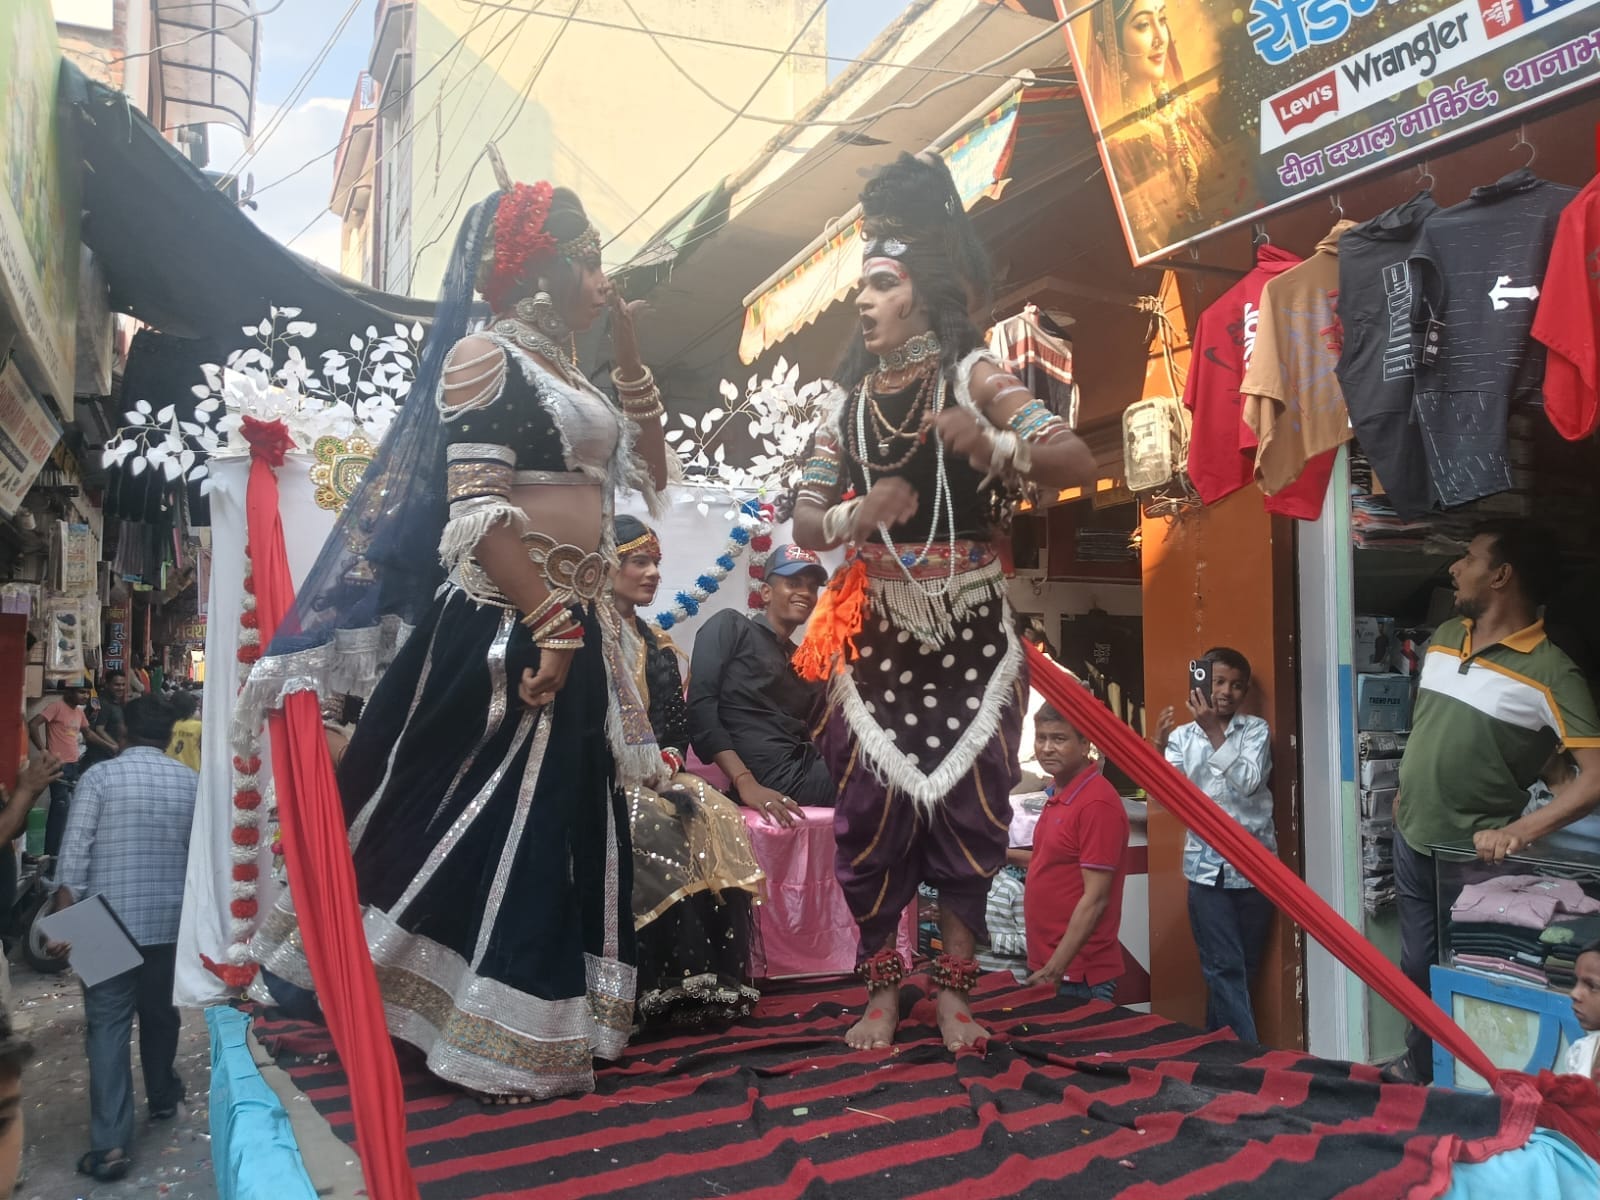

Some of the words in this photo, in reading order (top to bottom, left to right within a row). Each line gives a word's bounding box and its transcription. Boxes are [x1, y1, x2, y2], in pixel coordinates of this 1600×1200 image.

[1341, 11, 1469, 94] Wrangler
[1277, 153, 1325, 187] दीन
[1324, 118, 1396, 167] दयाल
